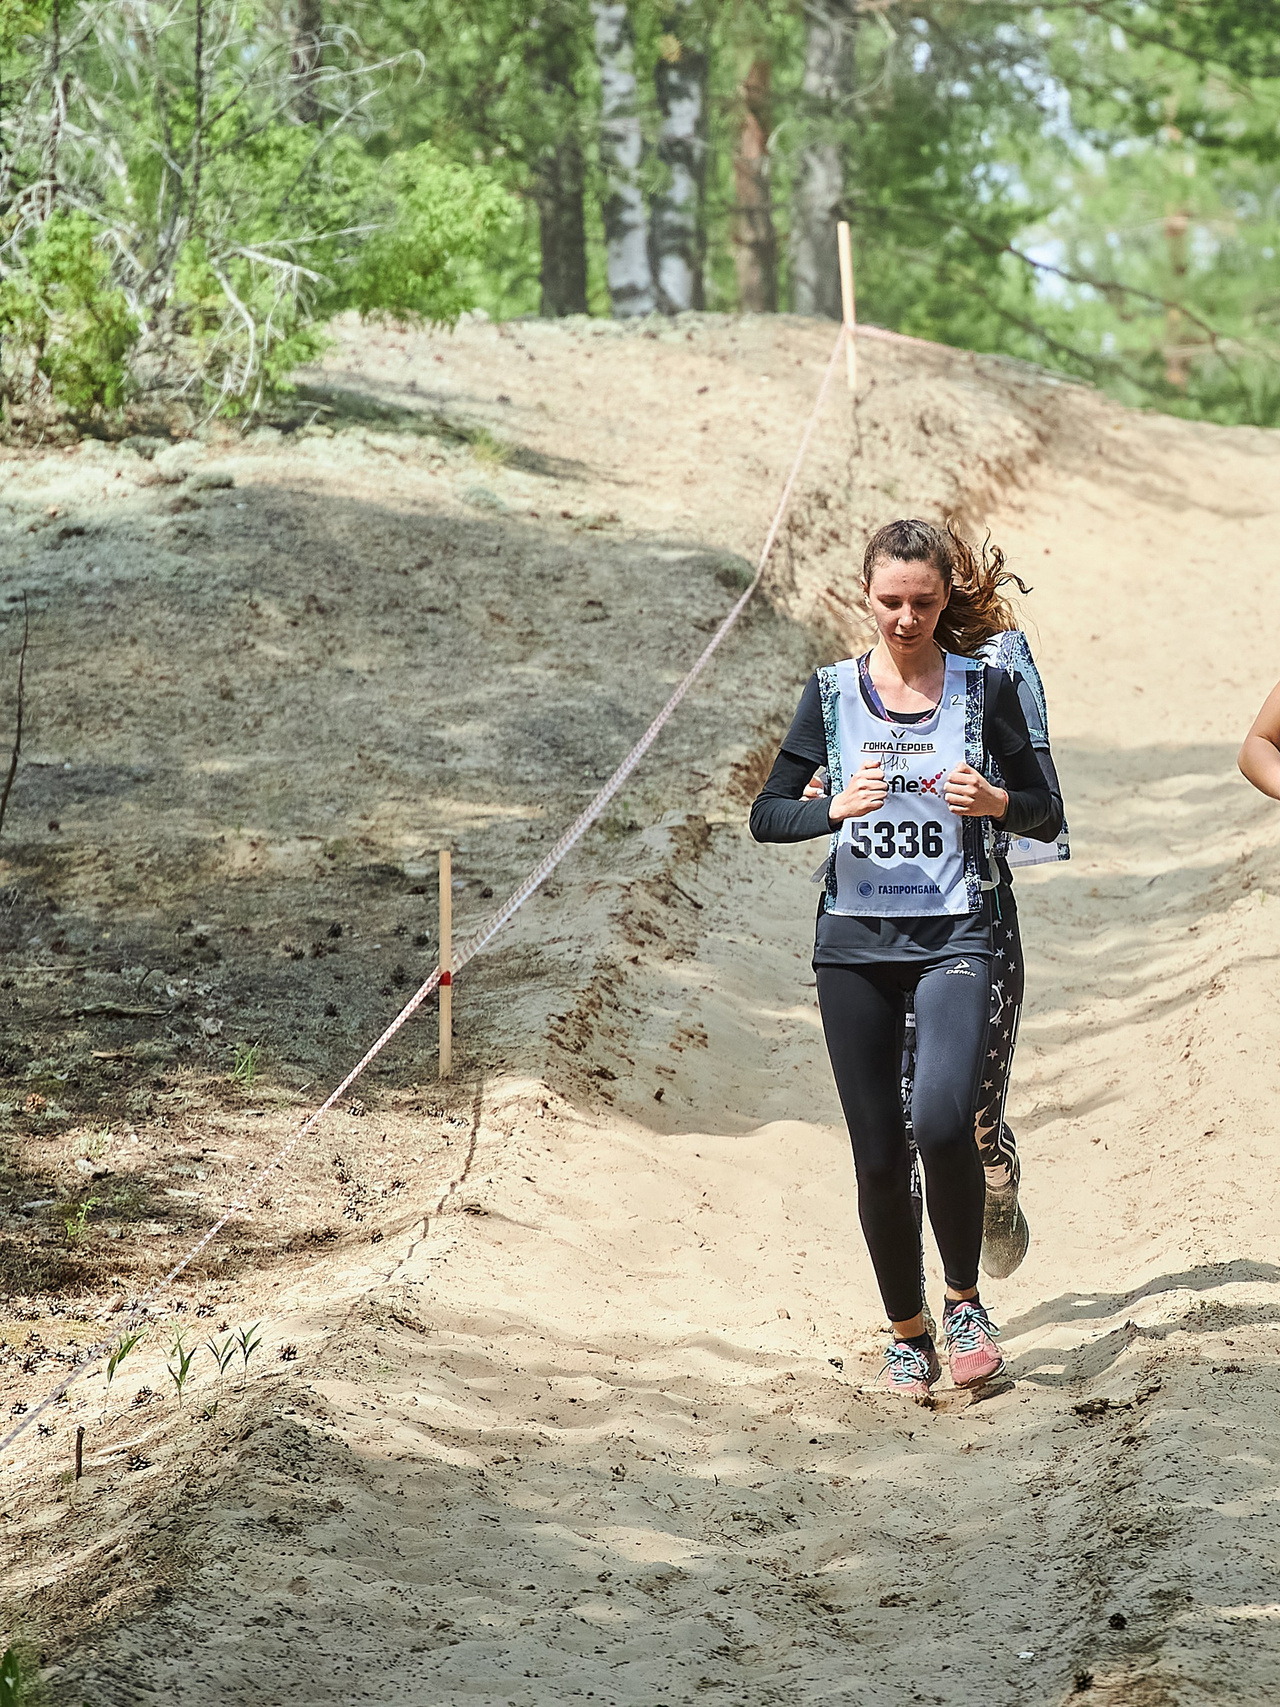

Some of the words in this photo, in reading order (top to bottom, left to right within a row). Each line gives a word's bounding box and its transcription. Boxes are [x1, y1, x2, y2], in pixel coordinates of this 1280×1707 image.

[950, 694, 964, 707] 2
[863, 741, 894, 751] ГОНКА
[896, 742, 934, 752] ГЕРОЕВ
[884, 768, 946, 798] flex
[850, 820, 944, 859] 5336
[878, 883, 941, 896] ГАЗПРОМБАНК
